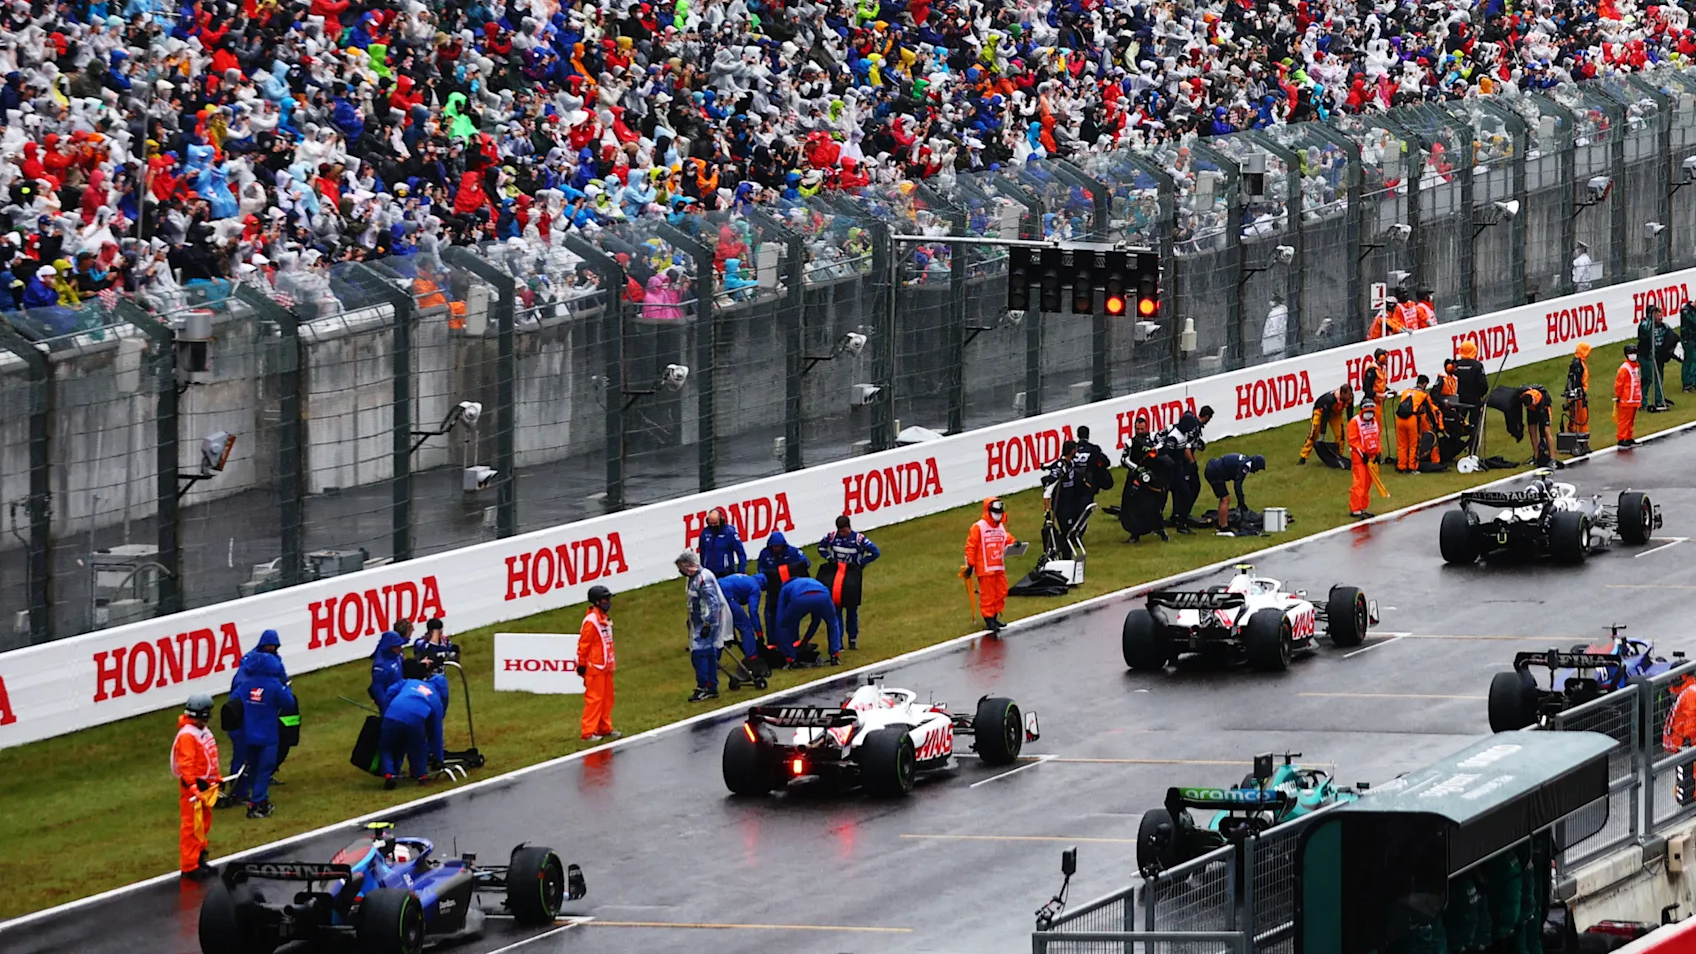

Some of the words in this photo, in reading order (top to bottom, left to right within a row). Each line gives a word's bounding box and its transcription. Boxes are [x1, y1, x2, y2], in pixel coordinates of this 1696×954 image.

[1547, 301, 1609, 345] HONDA
[1633, 283, 1690, 323] HONDA
[1235, 370, 1315, 421] HONDA
[842, 456, 944, 517] HONDA
[504, 531, 630, 602] HONDA
[307, 575, 446, 651] HONDA
[93, 621, 243, 703] HONDA
[504, 658, 577, 673] HOND
[915, 724, 954, 761] HAAS
[1185, 788, 1271, 801] aramco
[243, 862, 335, 878] SOFINA
